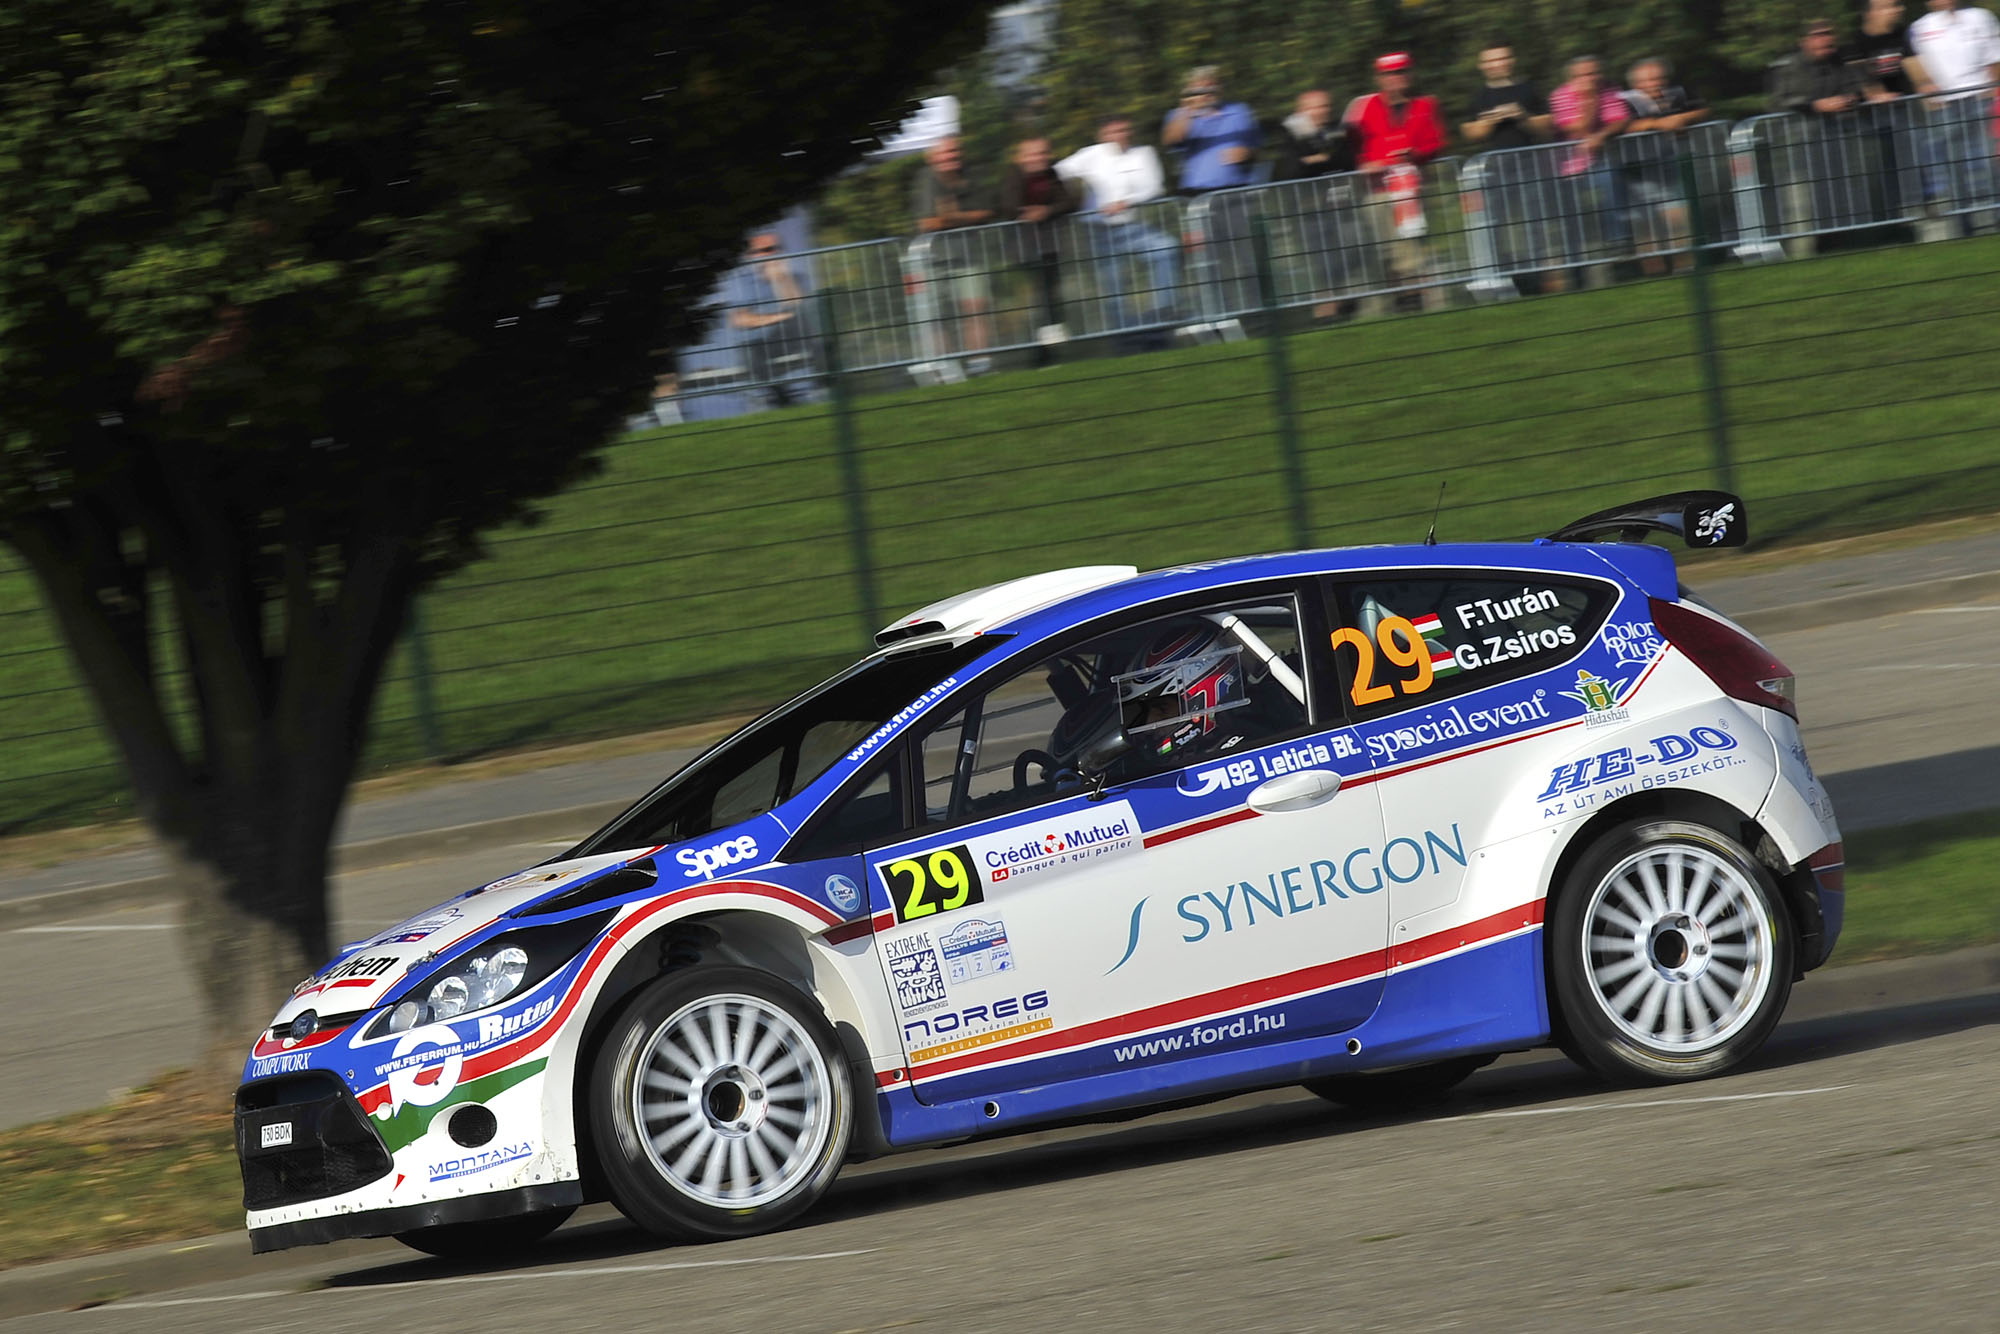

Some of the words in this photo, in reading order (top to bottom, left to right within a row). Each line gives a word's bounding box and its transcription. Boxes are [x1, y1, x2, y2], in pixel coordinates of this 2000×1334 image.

[1455, 587, 1560, 629] F.Turán
[1455, 625, 1577, 670] G.Zsiros
[1601, 621, 1655, 643] Color
[1605, 637, 1661, 662] Plus
[1331, 615, 1435, 705] 29
[1226, 759, 1258, 787] 92
[1259, 743, 1331, 778] Leticia
[1331, 734, 1362, 759] Bt.
[1537, 726, 1738, 803] HE-DO
[1543, 803, 1567, 819] AZ
[1574, 793, 1595, 809] ÚT
[1604, 783, 1634, 800] AMI
[676, 835, 759, 880] Spice
[985, 840, 1043, 868] Crédit
[1065, 819, 1130, 849] Mutuel
[994, 871, 1008, 881] LA
[1011, 860, 1055, 876] banque
[1060, 855, 1066, 863] à
[1072, 848, 1090, 862] qui
[1095, 840, 1132, 857] parler
[888, 849, 970, 921] 29
[1177, 823, 1468, 943] SYNERGON
[884, 931, 932, 959] EXTREME
[949, 934, 968, 944] Crédit
[975, 926, 997, 937] Mutuel
[478, 994, 555, 1045] Rutin
[903, 990, 1049, 1041] NOREG
[375, 1041, 480, 1076] WWW.FEFERRUM.HU
[1114, 1012, 1286, 1063] www.ford.hu
[252, 1052, 312, 1078] COMPUWORX
[263, 1127, 274, 1143] 750
[428, 1142, 532, 1176] MONTANA
